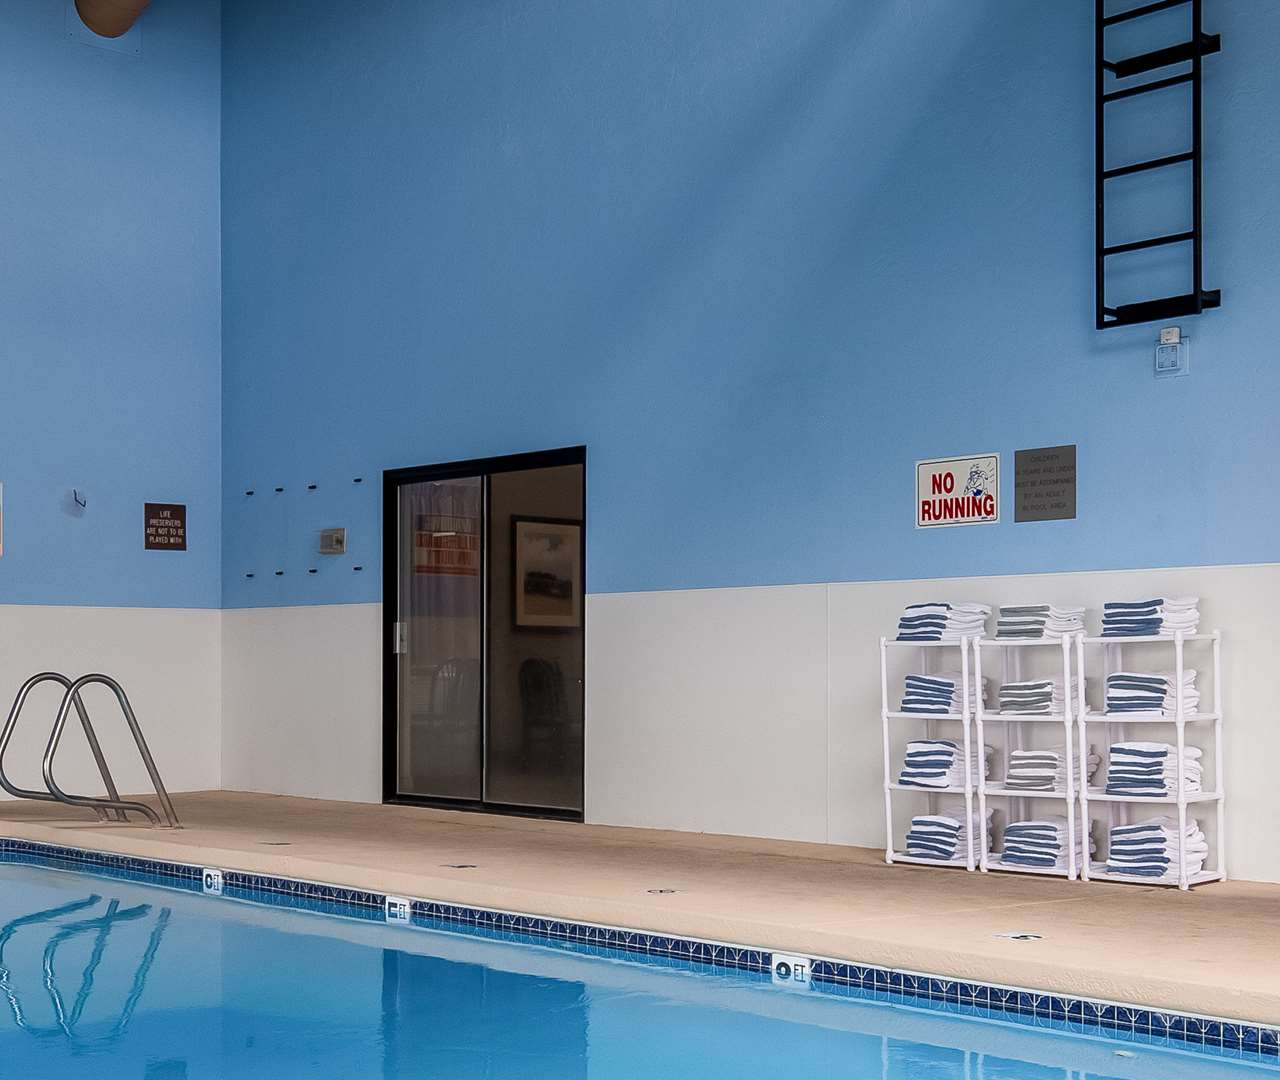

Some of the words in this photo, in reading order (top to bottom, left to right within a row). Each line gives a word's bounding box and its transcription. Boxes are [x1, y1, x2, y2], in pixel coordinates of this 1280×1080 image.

[932, 471, 955, 495] NO
[921, 494, 995, 521] RUNNING
[157, 527, 168, 535] NOT
